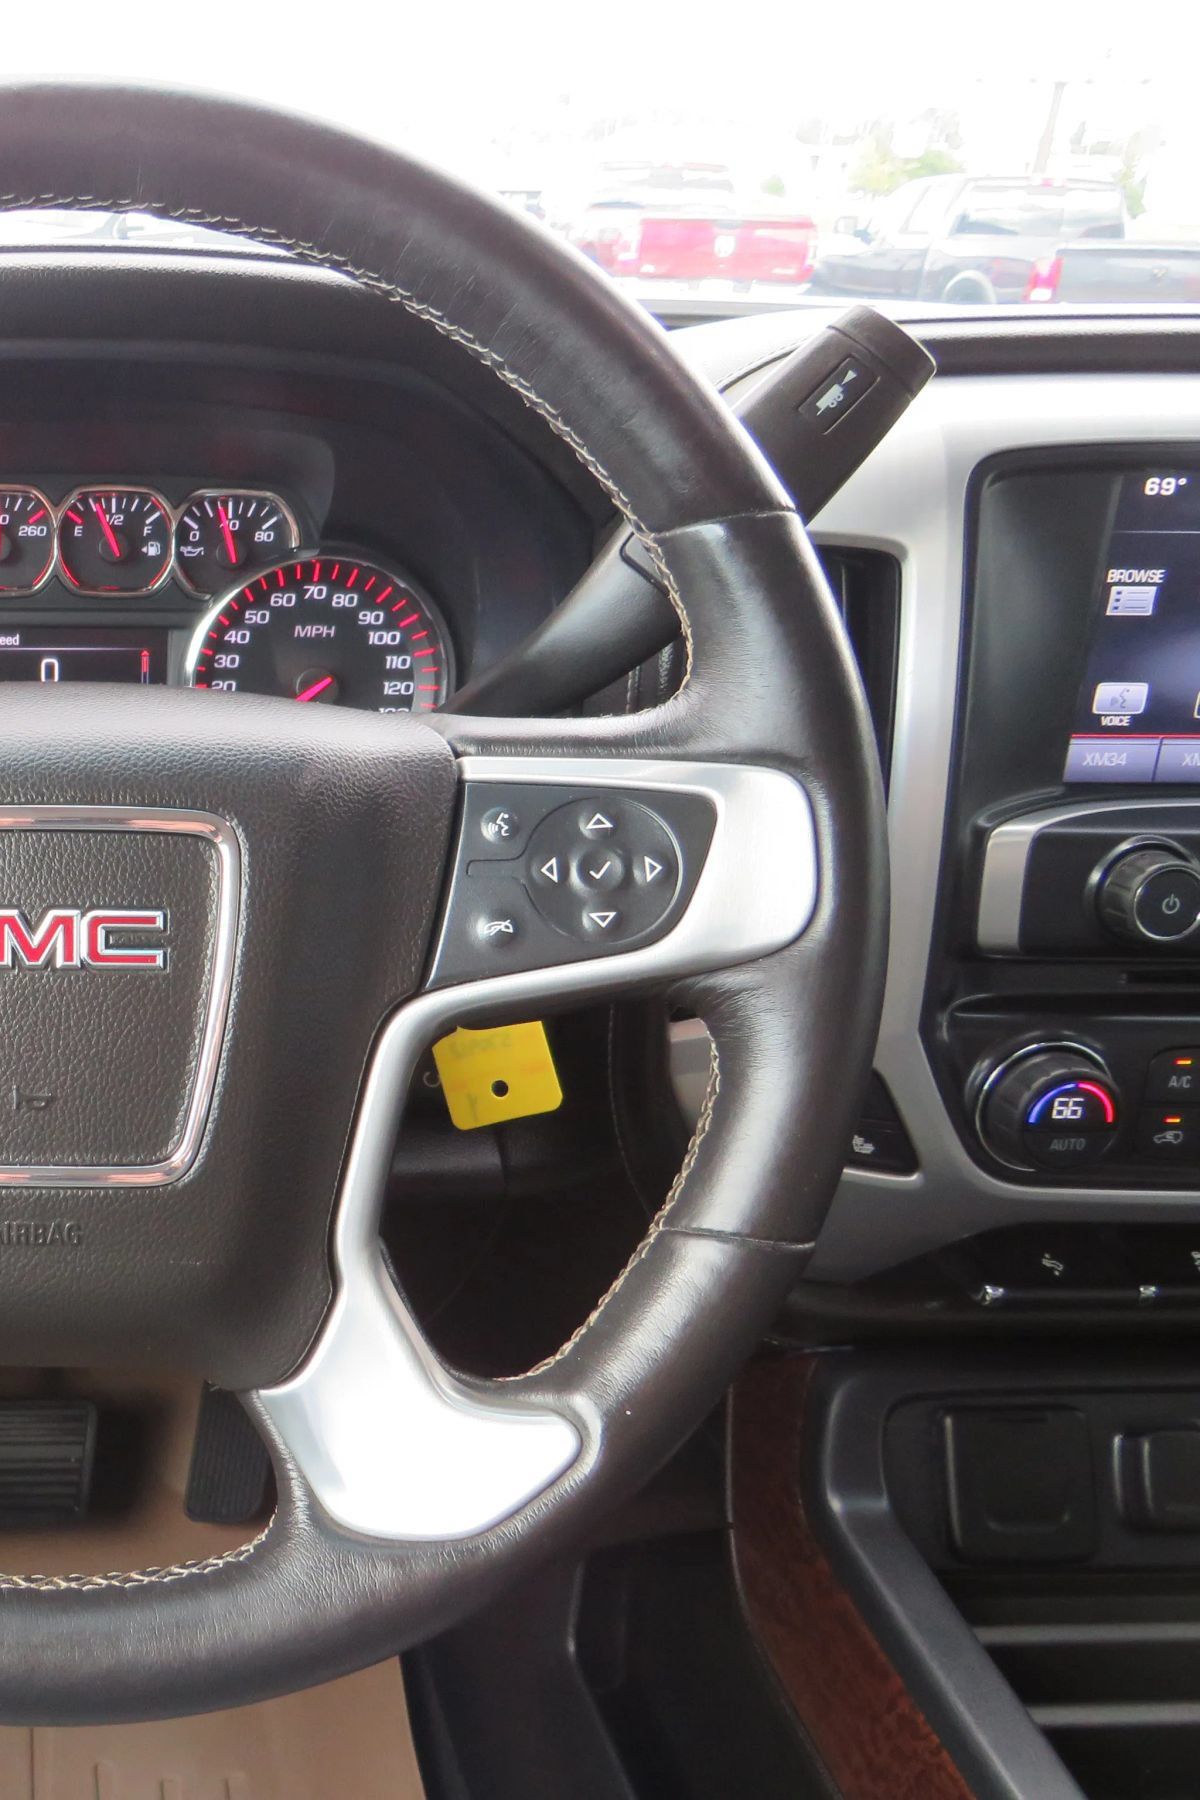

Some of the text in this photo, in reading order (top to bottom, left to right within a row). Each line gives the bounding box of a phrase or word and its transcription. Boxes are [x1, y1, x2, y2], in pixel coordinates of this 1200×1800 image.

[18, 526, 48, 538] 260
[73, 526, 84, 537] E
[143, 526, 153, 537] F
[190, 530, 200, 542] 0
[254, 531, 275, 543] 80
[1106, 568, 1166, 583] BROWSE
[303, 585, 327, 600] 70
[270, 593, 296, 607] 60
[331, 593, 358, 608] 80
[244, 610, 270, 624] 50
[357, 611, 384, 625] 90
[224, 630, 250, 645] 40
[294, 625, 336, 638] MPH
[367, 630, 400, 645] 100
[214, 654, 240, 669] 30
[385, 655, 411, 670] 110
[383, 681, 414, 696] 120
[1100, 715, 1131, 726] VOICE
[1082, 752, 1127, 767] XM34
[1168, 1075, 1193, 1089] A/C
[1051, 1097, 1084, 1119] 66
[1050, 1138, 1086, 1151] AUTO
